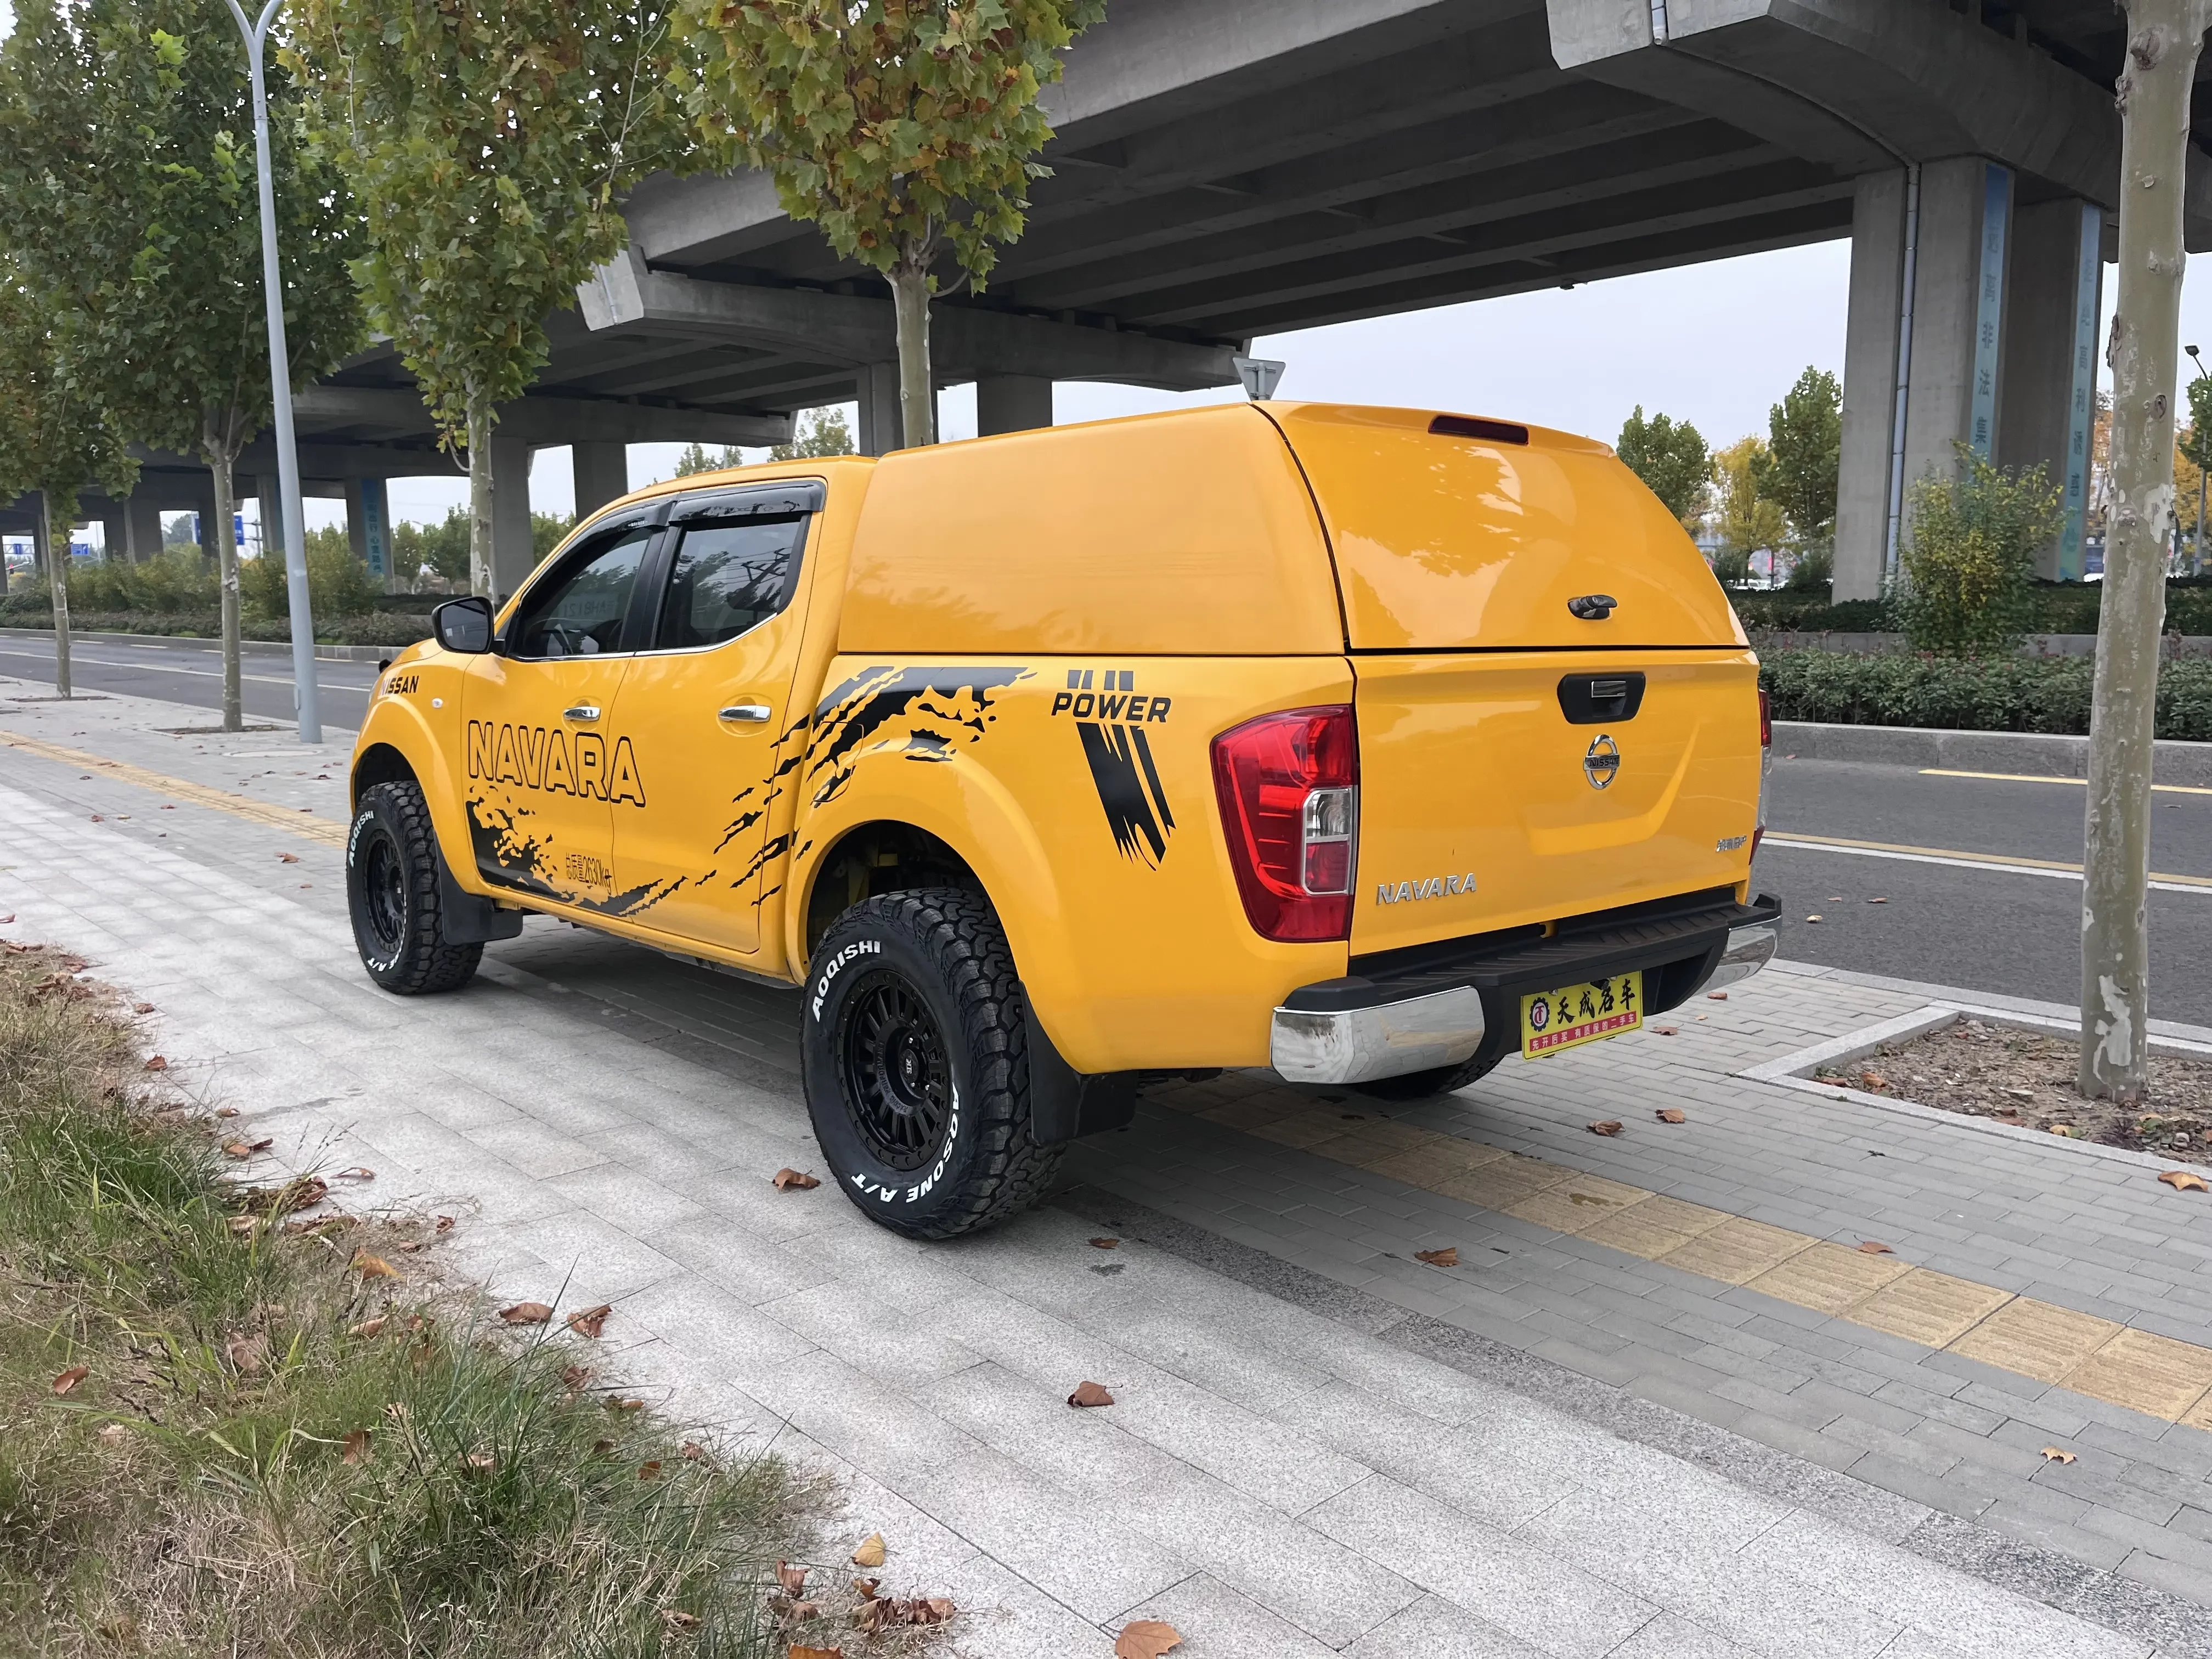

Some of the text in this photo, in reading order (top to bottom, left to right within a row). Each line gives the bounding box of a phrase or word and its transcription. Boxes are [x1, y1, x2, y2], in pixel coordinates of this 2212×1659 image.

[381, 675, 419, 696] NISSAN
[1051, 692, 1171, 723] POWER
[468, 719, 646, 808] NAVARA
[349, 810, 374, 868] AOQISHI
[1376, 872, 1477, 905] NAVARA
[812, 940, 881, 1023] AOQISHI
[1532, 1013, 1635, 1051] 先开后买 有质保的二手车
[851, 1081, 959, 1203] AQSONE A/T
